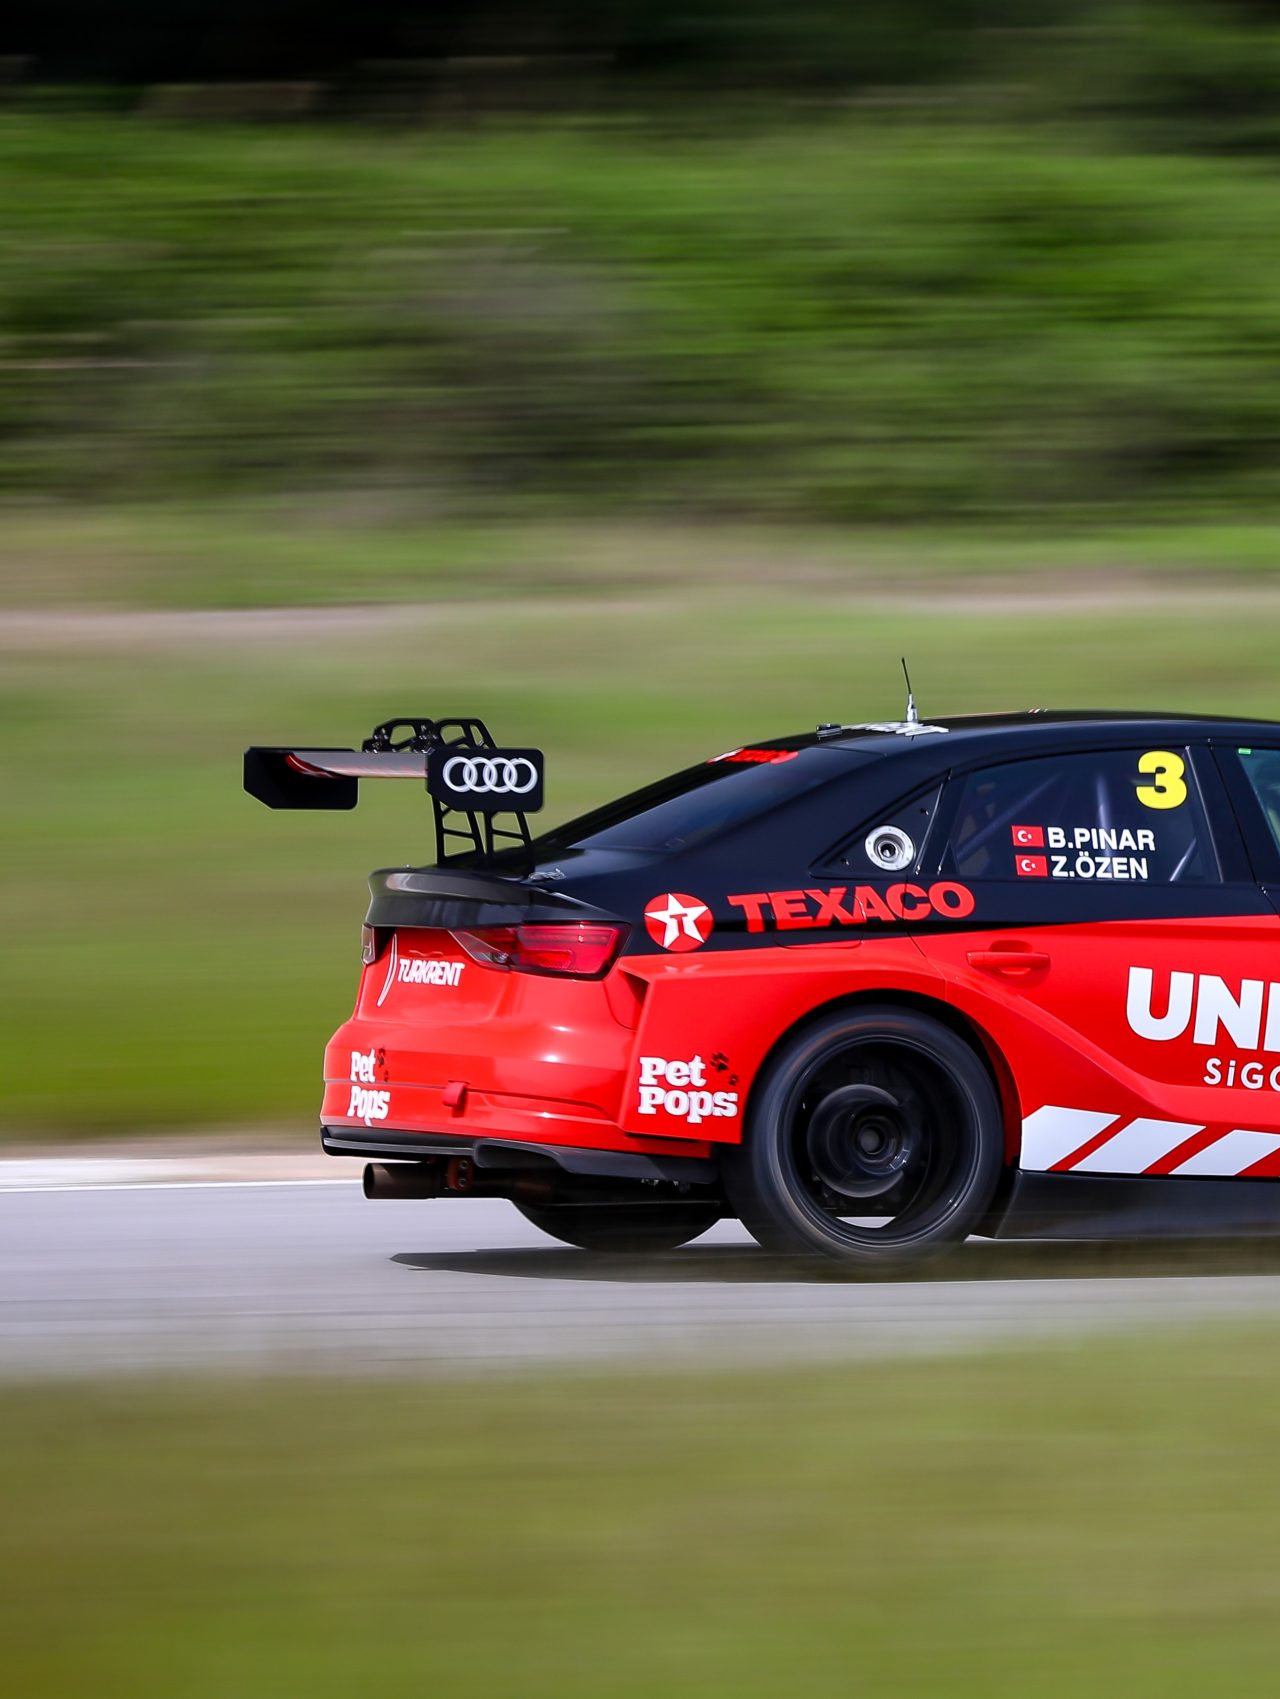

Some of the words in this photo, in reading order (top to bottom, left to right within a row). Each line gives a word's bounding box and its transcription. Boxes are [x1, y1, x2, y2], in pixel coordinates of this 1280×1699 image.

[1136, 750, 1188, 810] 3
[1047, 826, 1156, 851] B.PINAR
[1050, 851, 1149, 880] Z.ÖZEN
[727, 881, 975, 933] TEXACO
[350, 1048, 376, 1083] Pet
[639, 1055, 707, 1087] Pet
[347, 1085, 391, 1127] Pops
[638, 1086, 738, 1124] Pops
